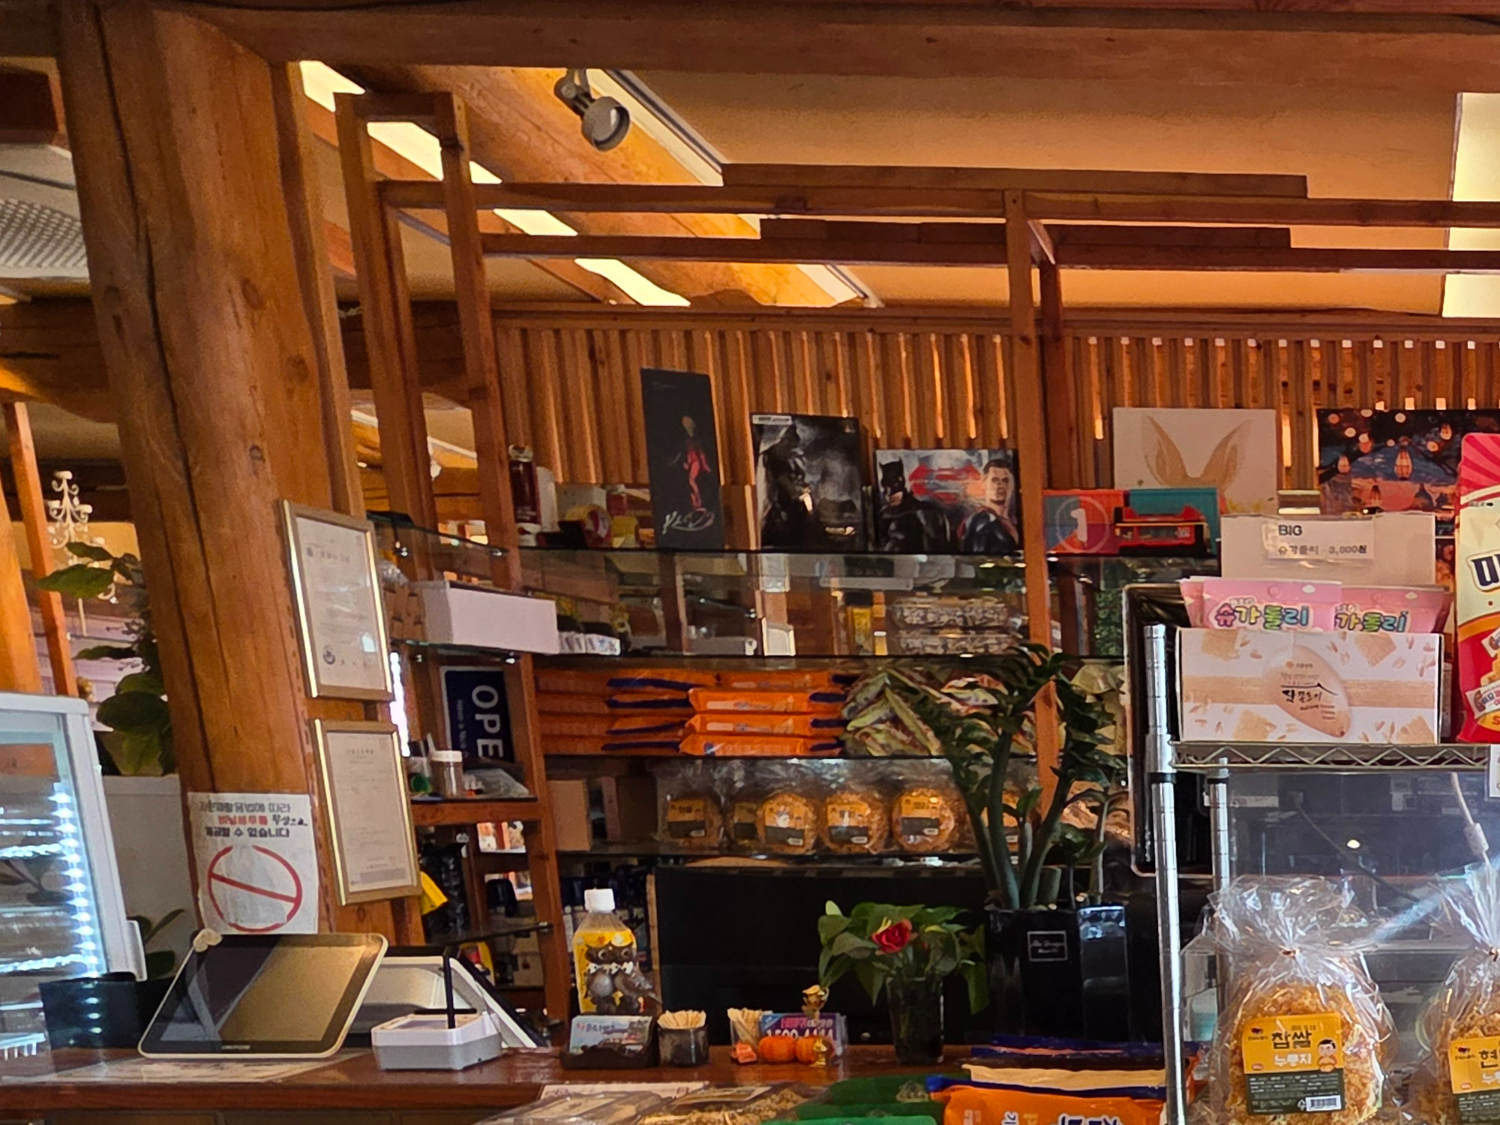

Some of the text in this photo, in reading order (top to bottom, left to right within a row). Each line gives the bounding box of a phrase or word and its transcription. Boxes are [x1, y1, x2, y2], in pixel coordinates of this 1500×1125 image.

[1278, 525, 1303, 536] BIG
[471, 685, 504, 757] OPE
[1270, 1030, 1312, 1050] 찹쌀
[1273, 1054, 1312, 1068] 누룽지
